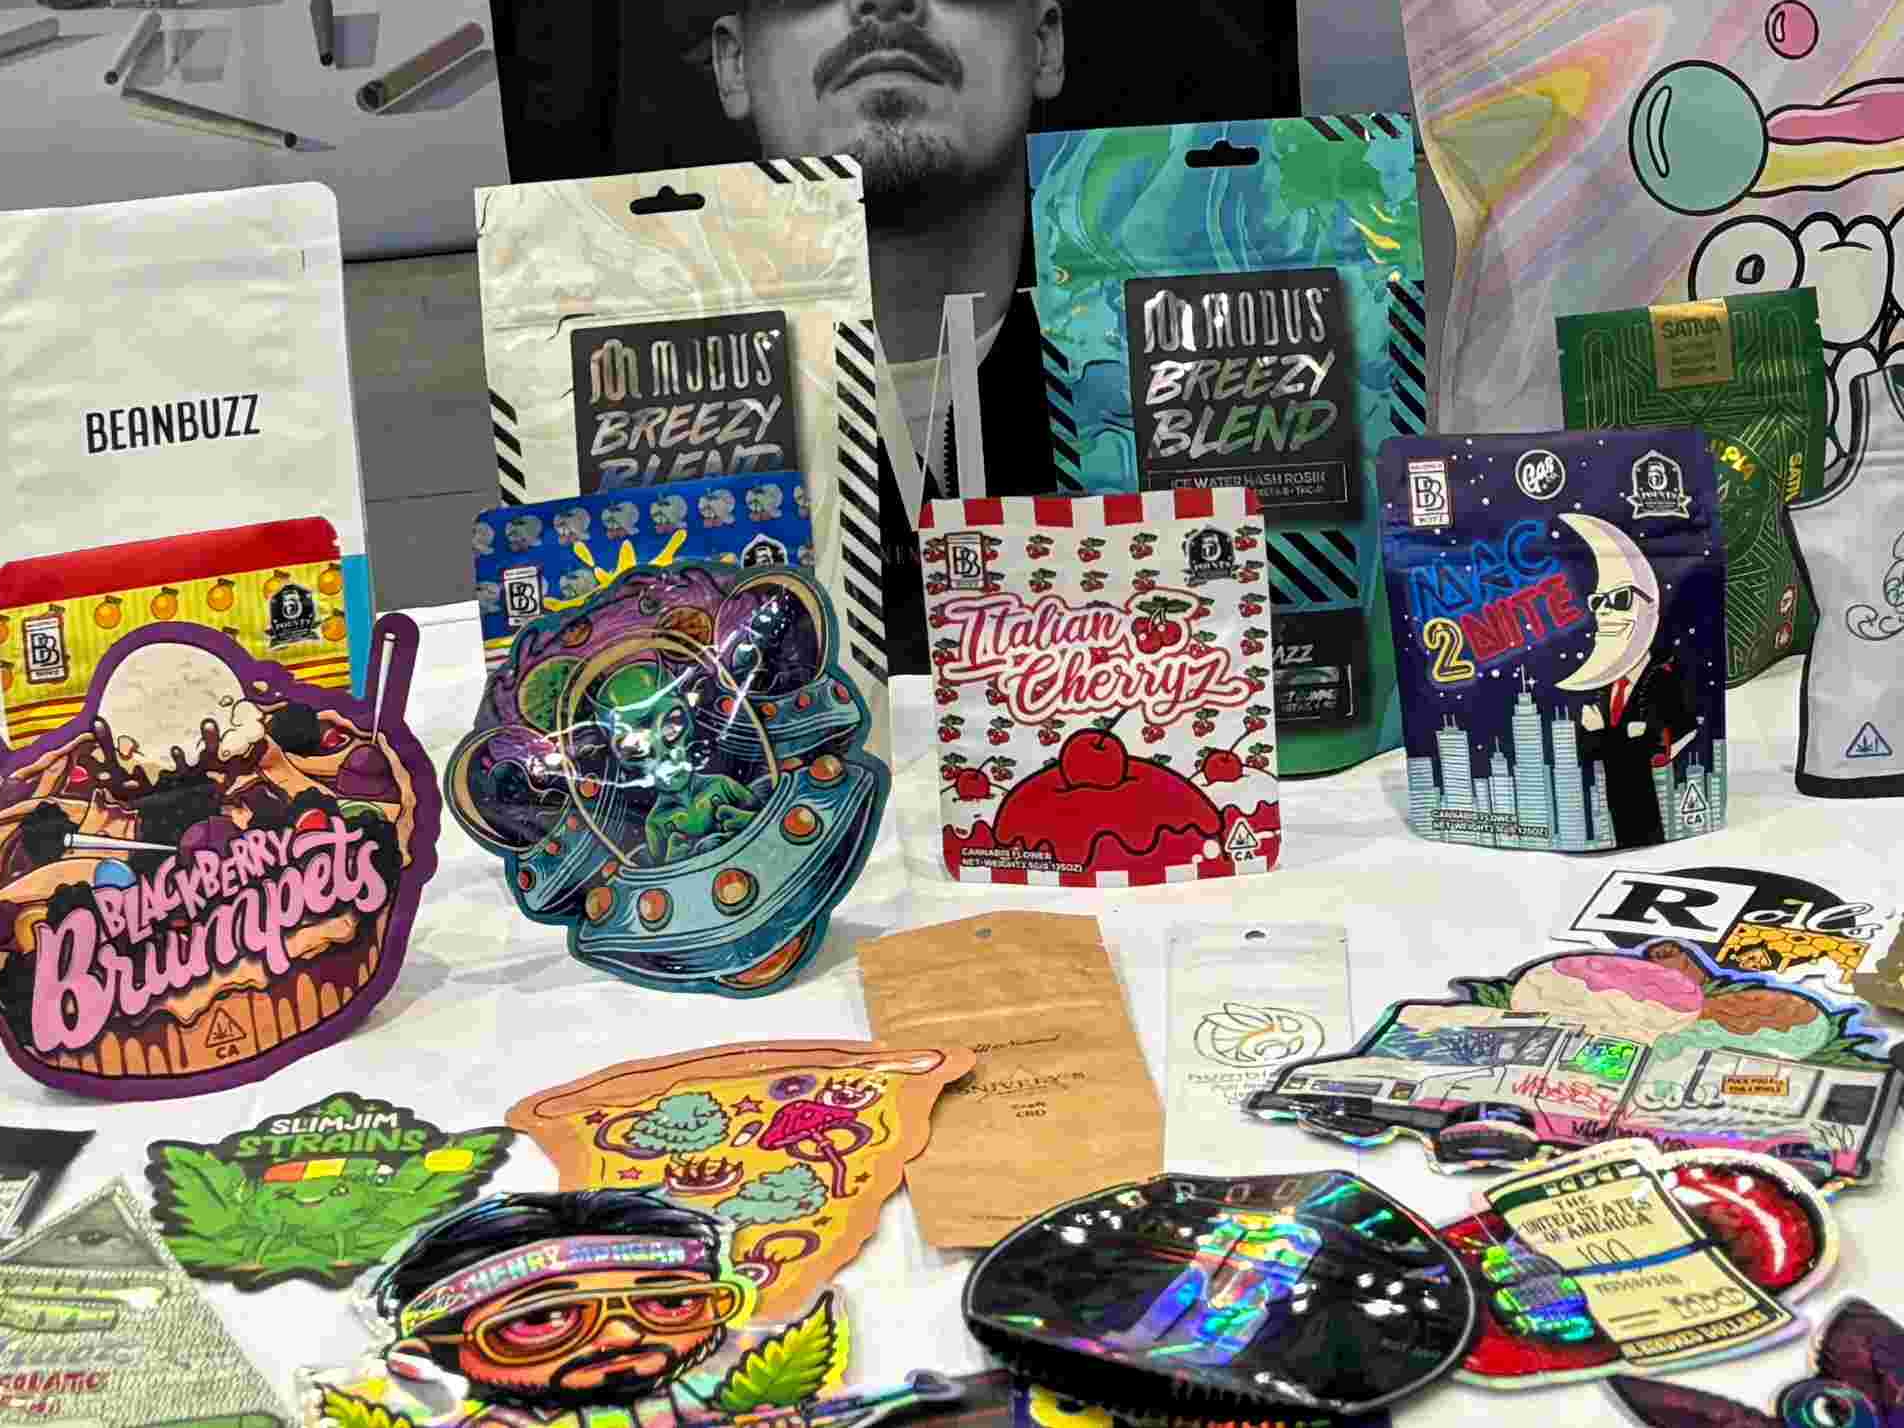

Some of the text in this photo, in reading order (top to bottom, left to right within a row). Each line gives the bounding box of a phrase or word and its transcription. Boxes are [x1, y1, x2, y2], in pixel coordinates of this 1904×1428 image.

[1145, 351, 1335, 406] BREEZY
[85, 393, 261, 454] BEANBUZZ
[591, 394, 782, 457] BREEZY
[1153, 399, 1339, 460] BLEND
[1410, 519, 1558, 619] MAC
[959, 601, 1121, 668] Italian
[1423, 573, 1584, 683] 2 NITE
[97, 829, 296, 944] BLACKBERRY
[32, 817, 385, 1052] Brumpets
[215, 1045, 241, 1059] CA
[235, 1127, 428, 1160] STRAINS
[271, 1111, 400, 1135] SLIMJIM
[1522, 1210, 1577, 1237] UNITED
[1567, 1212, 1653, 1241] AMERICA
